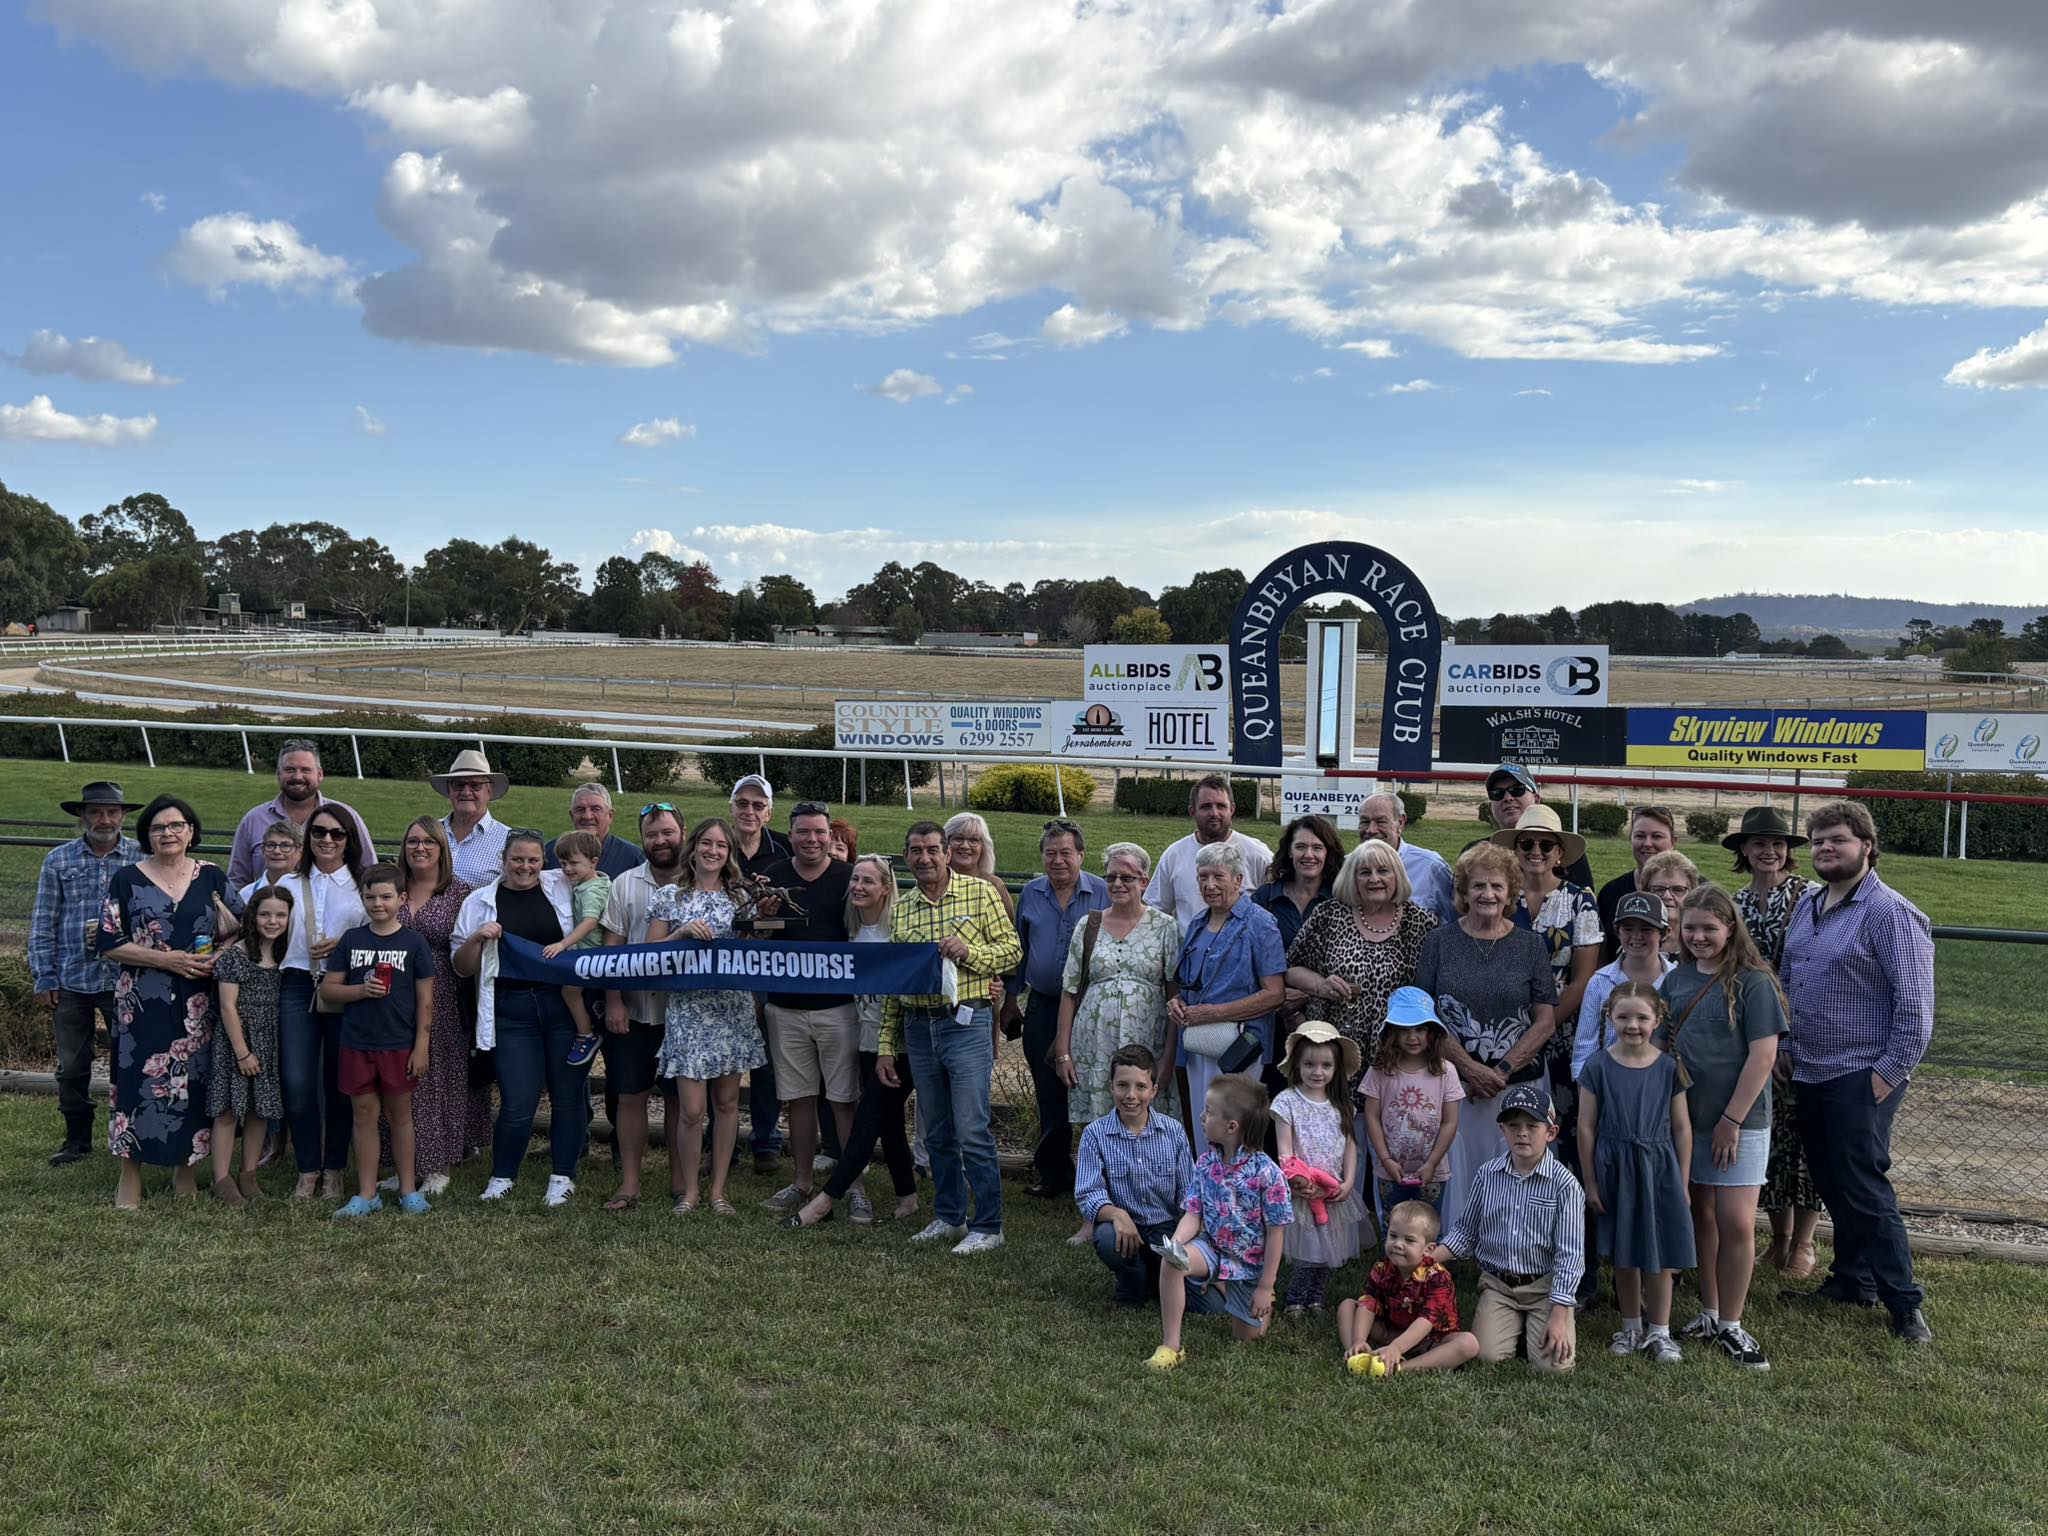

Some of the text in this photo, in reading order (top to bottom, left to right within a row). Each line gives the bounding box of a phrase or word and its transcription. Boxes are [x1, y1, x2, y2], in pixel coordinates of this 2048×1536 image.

[1240, 554, 1428, 743] QUEANBEYAN RACE CLUB
[1090, 663, 1171, 678] ALLBIDS
[1447, 664, 1542, 680] CARBIDS
[1089, 681, 1171, 693] auctionplace
[1447, 683, 1541, 695] auctionplace
[838, 704, 943, 718] COUNTRY
[950, 706, 1042, 719] QUALITY WINDOWS
[1486, 706, 1582, 729] WALSH'S HOTEL
[838, 718, 944, 734] STYLE
[975, 719, 1018, 731] & DOORS
[1149, 712, 1215, 745] HOTEL
[1669, 716, 1884, 746] Skyview Windows
[838, 734, 945, 746] WINDOWS
[959, 732, 1034, 747] 6299 2557
[1062, 735, 1132, 753] Jerrabomberra
[1501, 756, 1559, 764] QUEANBEYAN
[1688, 750, 1858, 765] Quality Windows Fast
[1284, 792, 1366, 803] QUEANBEYA
[1294, 804, 1311, 813] 12
[1322, 805, 1330, 814] 4
[350, 949, 408, 972] NEW YORK
[575, 949, 856, 980] QUEANBEYAN RACECOURSE
